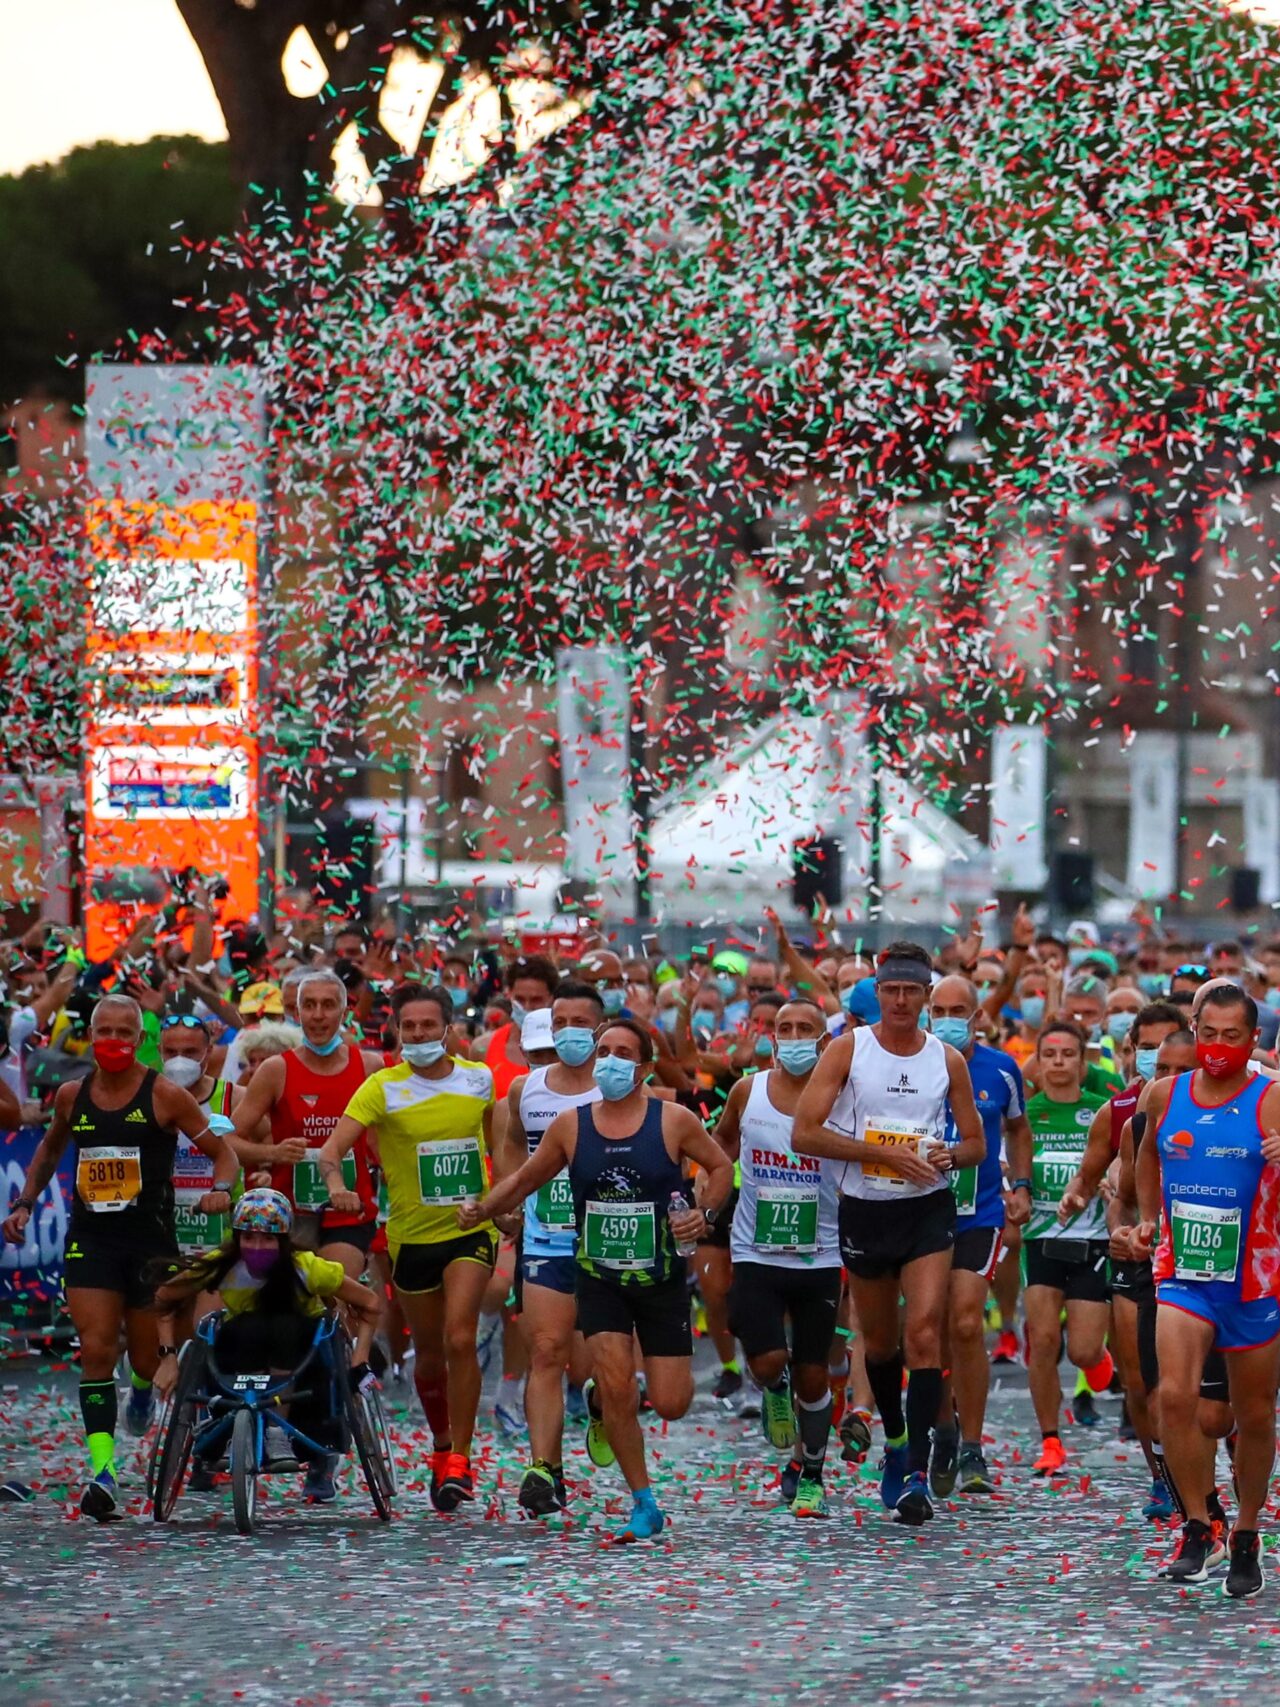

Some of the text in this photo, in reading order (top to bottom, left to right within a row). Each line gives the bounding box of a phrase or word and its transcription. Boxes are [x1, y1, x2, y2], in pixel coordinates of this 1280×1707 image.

[913, 1127, 929, 1135] 2021
[89, 1161, 125, 1182] 5818
[433, 1154, 470, 1176] 6072
[753, 1167, 822, 1183] MARATHON
[89, 1191, 123, 1202] 9 A
[434, 1185, 467, 1196] 9 B
[1170, 1183, 1237, 1197] Oleotecna
[604, 1206, 629, 1214] acea
[772, 1204, 800, 1225] 712
[1187, 1210, 1238, 1223] acea 2021
[545, 1213, 550, 1223] 1
[600, 1217, 639, 1239] 4599
[766, 1233, 799, 1244] 2 B
[1182, 1221, 1222, 1249] 1036
[601, 1247, 635, 1259] 7 B
[1176, 1256, 1215, 1271] 2 B
